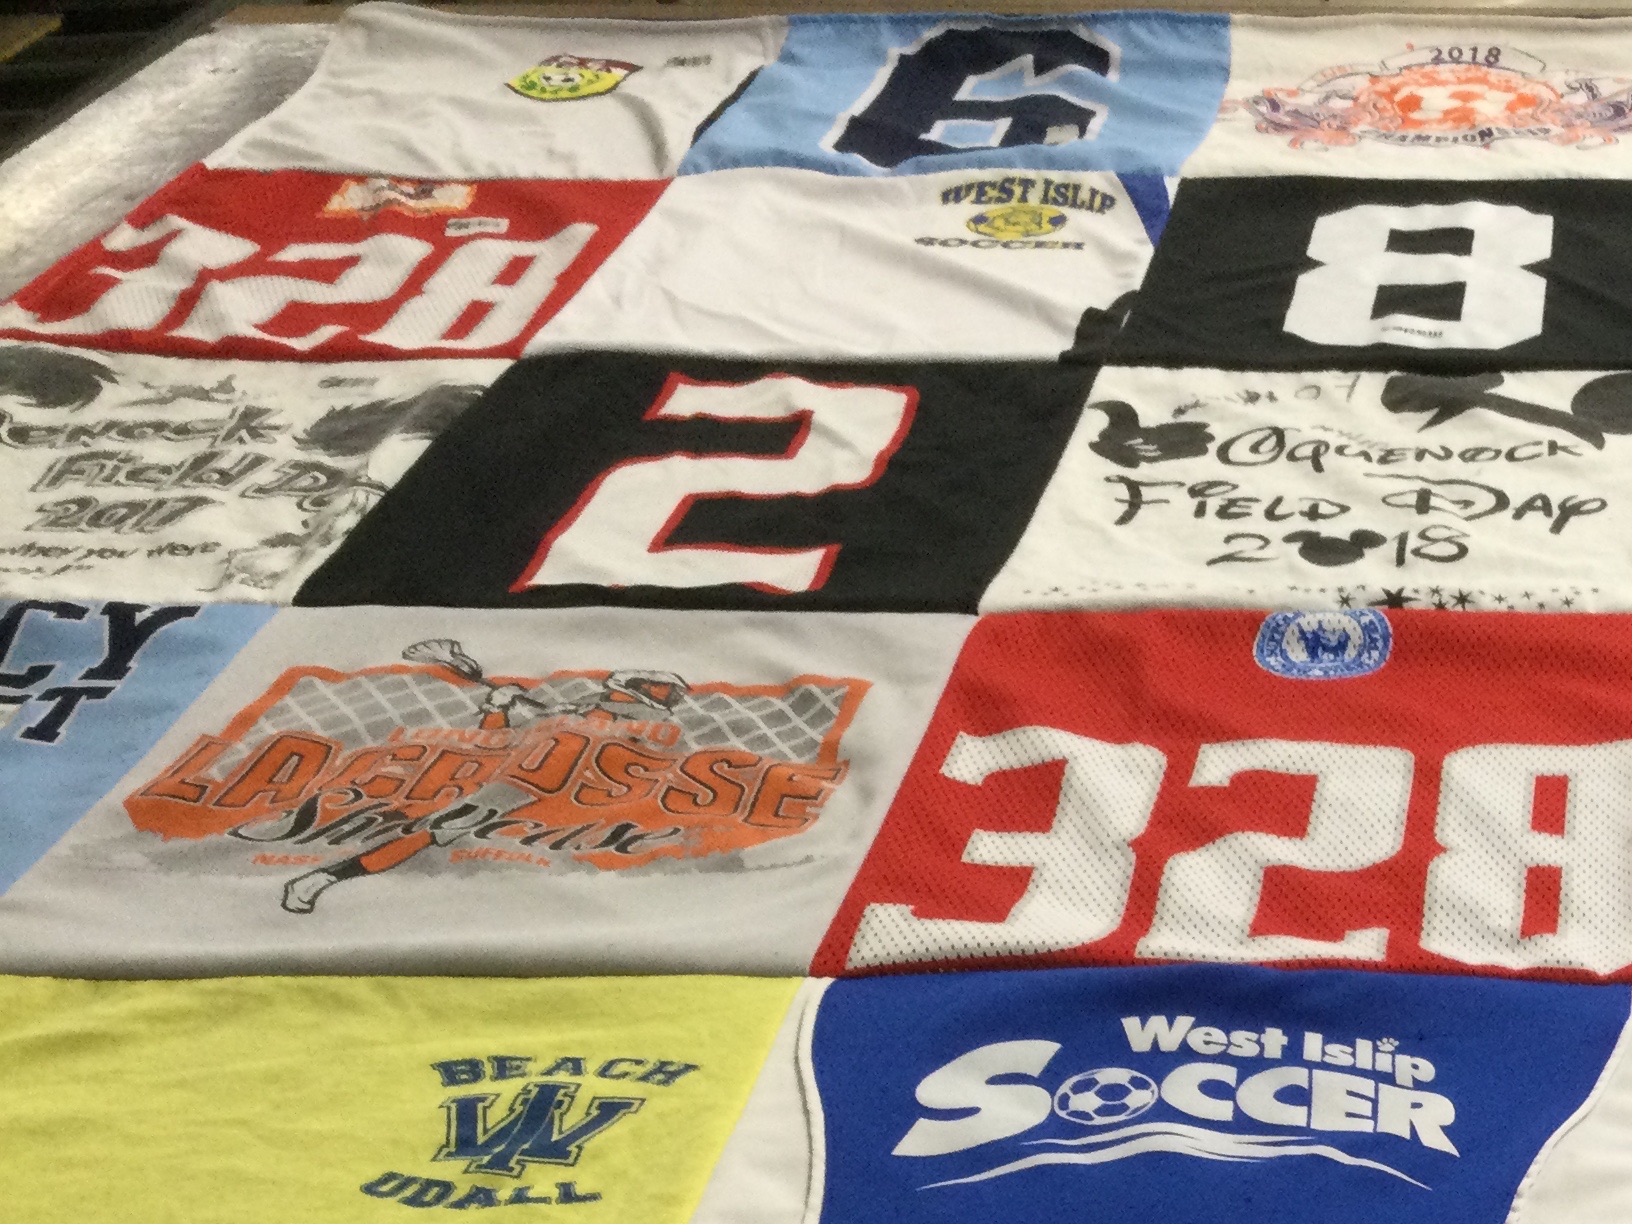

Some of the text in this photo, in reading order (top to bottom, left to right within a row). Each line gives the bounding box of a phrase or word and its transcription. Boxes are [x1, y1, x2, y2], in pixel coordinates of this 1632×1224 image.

[1429, 45, 1501, 64] 2018
[941, 177, 1117, 215] WEST ISLIP
[914, 237, 1086, 250] SOCCER
[1284, 202, 1555, 350] 8
[509, 371, 920, 596] 2
[136, 728, 850, 829] LACROSSE
[429, 1054, 702, 1087] BEACH
[1120, 1015, 1436, 1087] West Islip
[359, 1170, 604, 1211] UDALL
